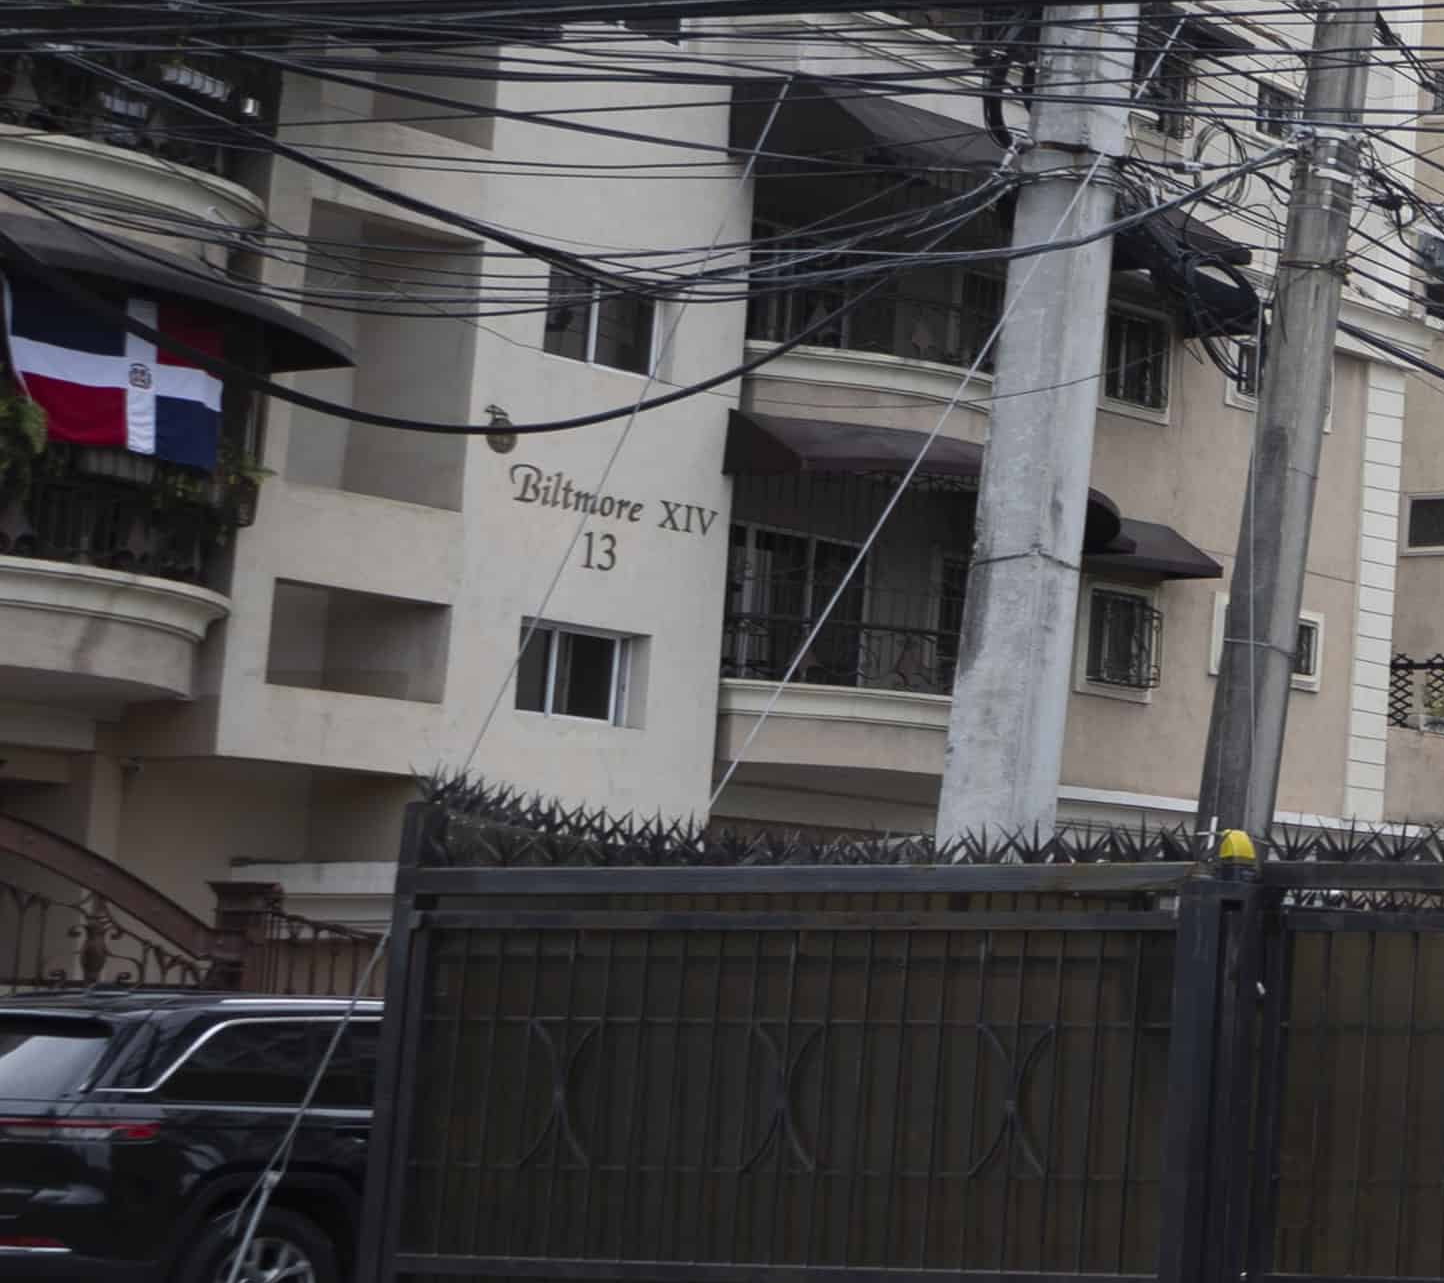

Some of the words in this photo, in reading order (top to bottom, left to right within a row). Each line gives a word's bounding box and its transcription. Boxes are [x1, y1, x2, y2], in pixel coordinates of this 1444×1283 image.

[509, 463, 644, 522] Biltmore
[657, 500, 719, 536] XIV
[582, 531, 617, 571] 13
